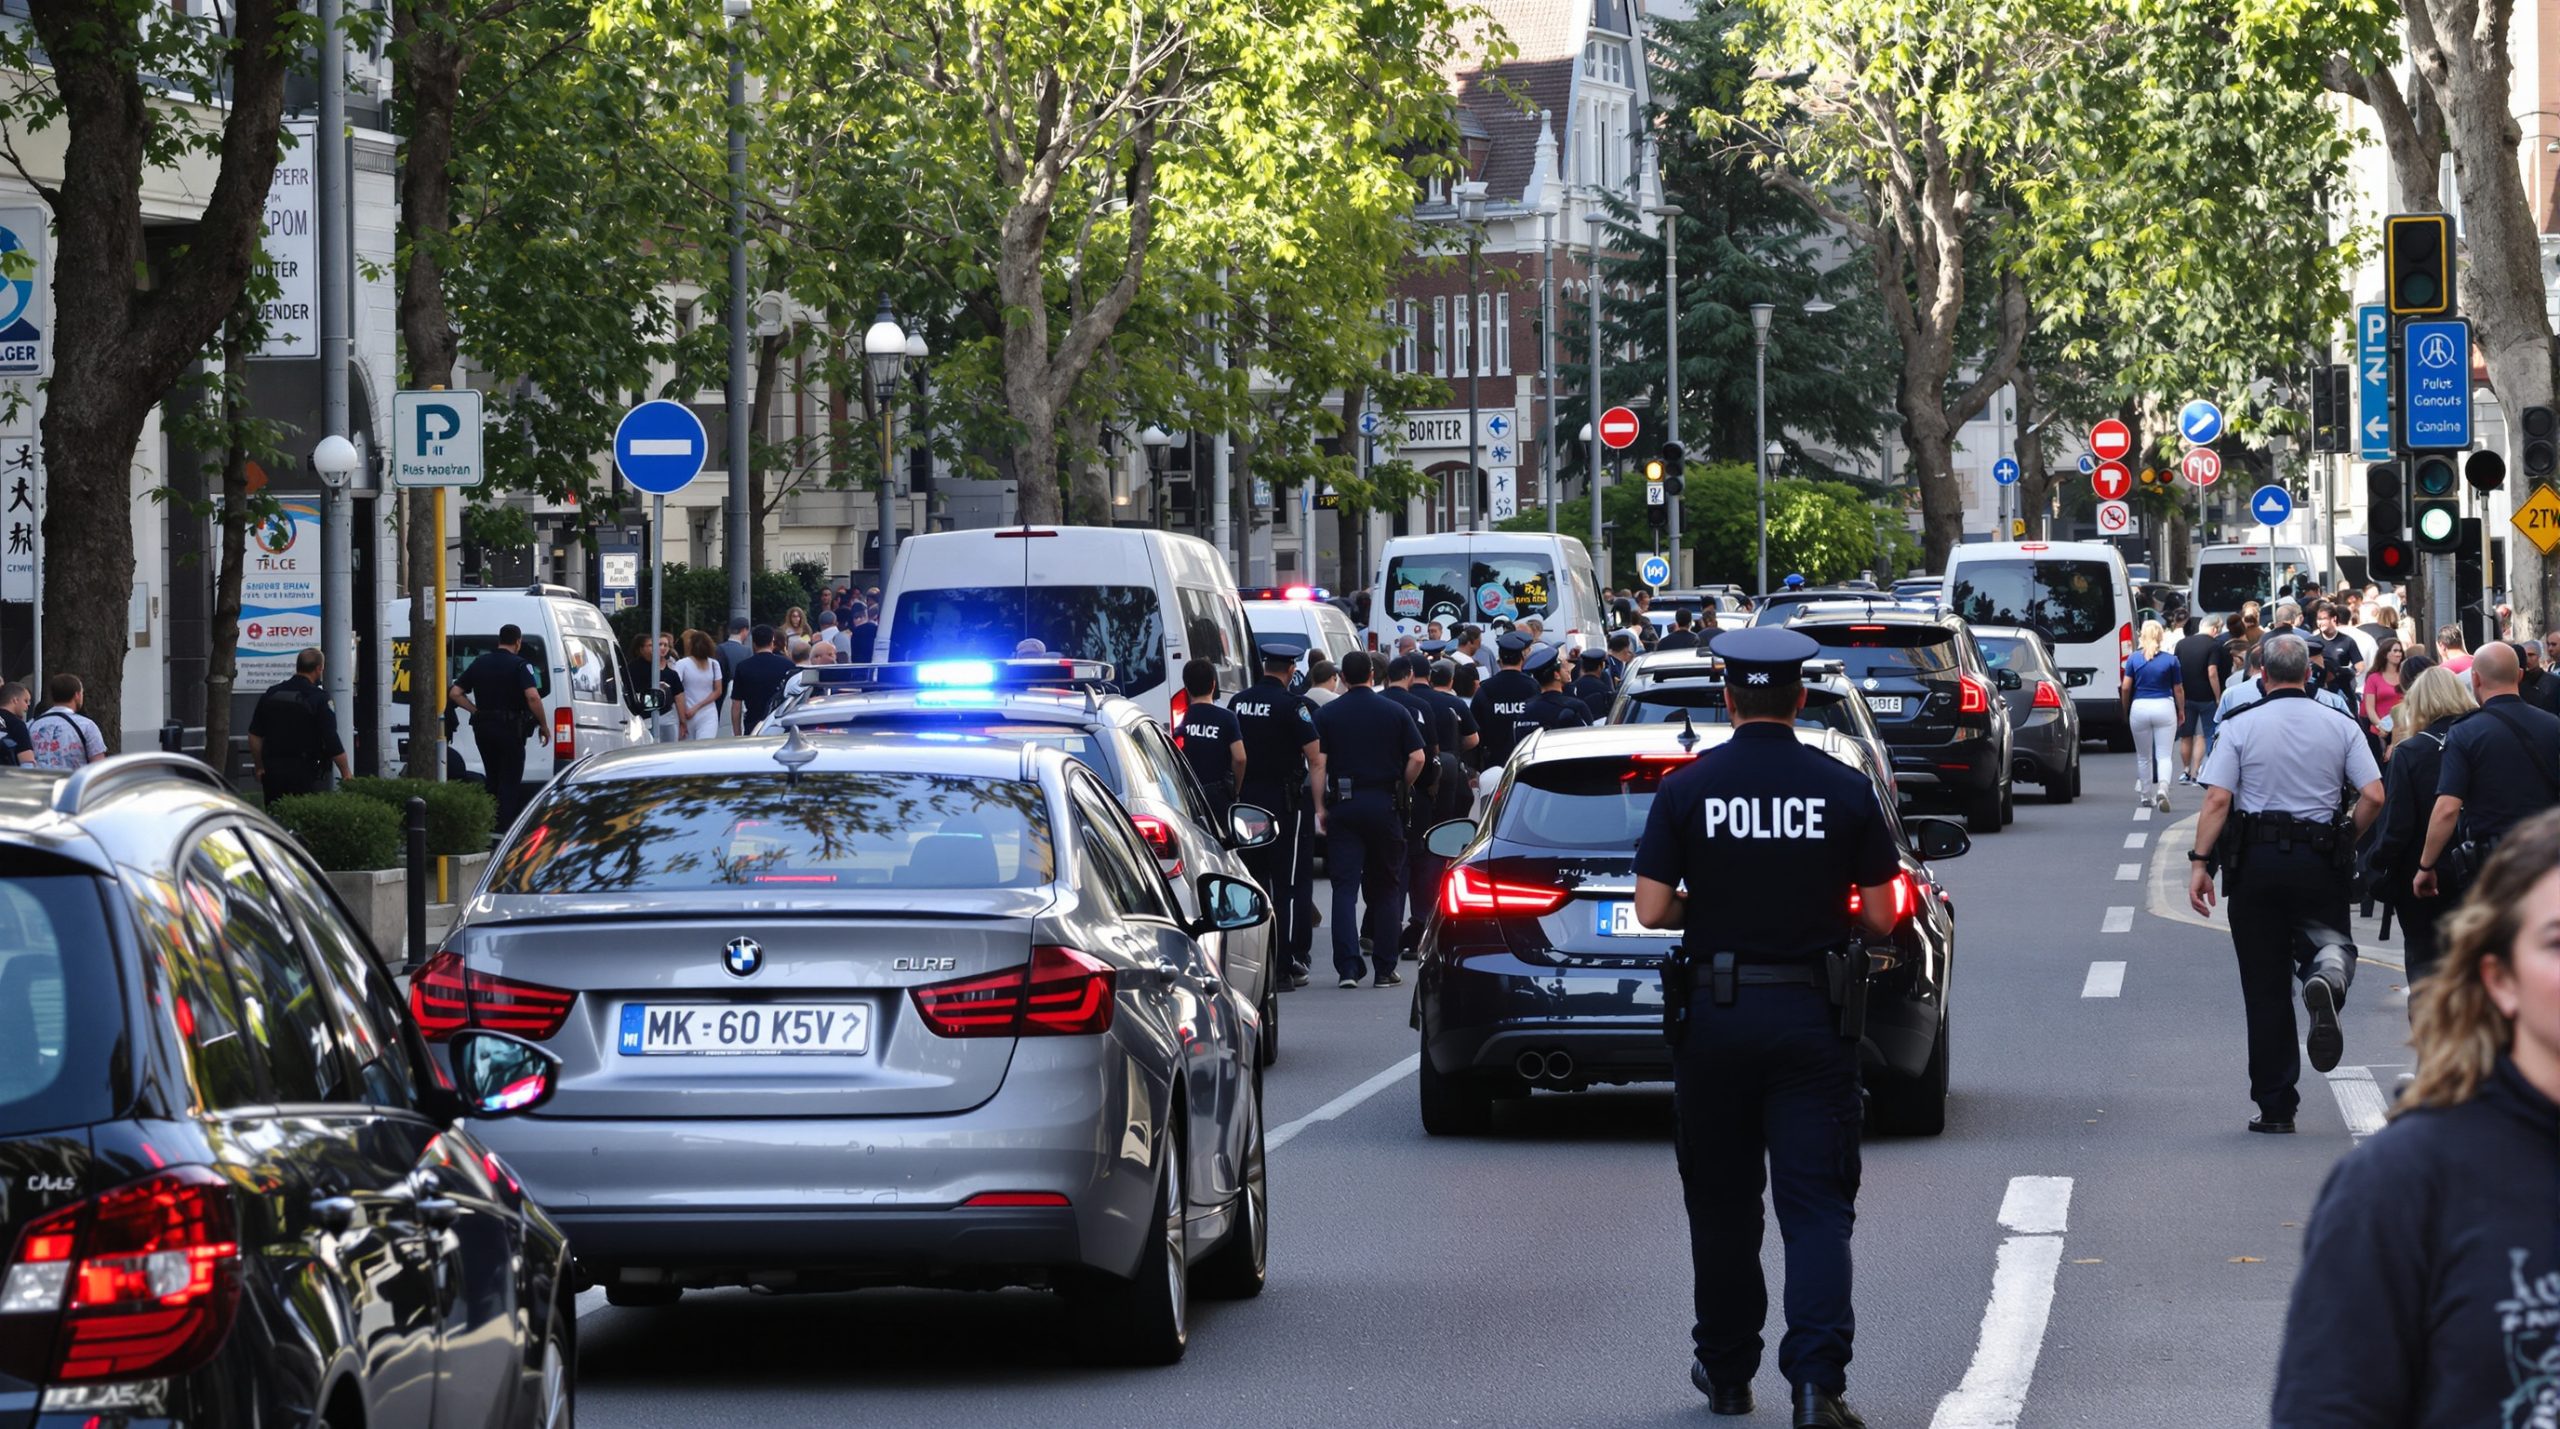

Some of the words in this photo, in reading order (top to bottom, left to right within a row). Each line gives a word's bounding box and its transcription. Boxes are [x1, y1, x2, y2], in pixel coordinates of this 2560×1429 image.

[0, 345, 36, 361] GER
[1409, 419, 1462, 441] BORTER
[1494, 702, 1526, 714] POLICE
[1705, 796, 1826, 839] POLICE
